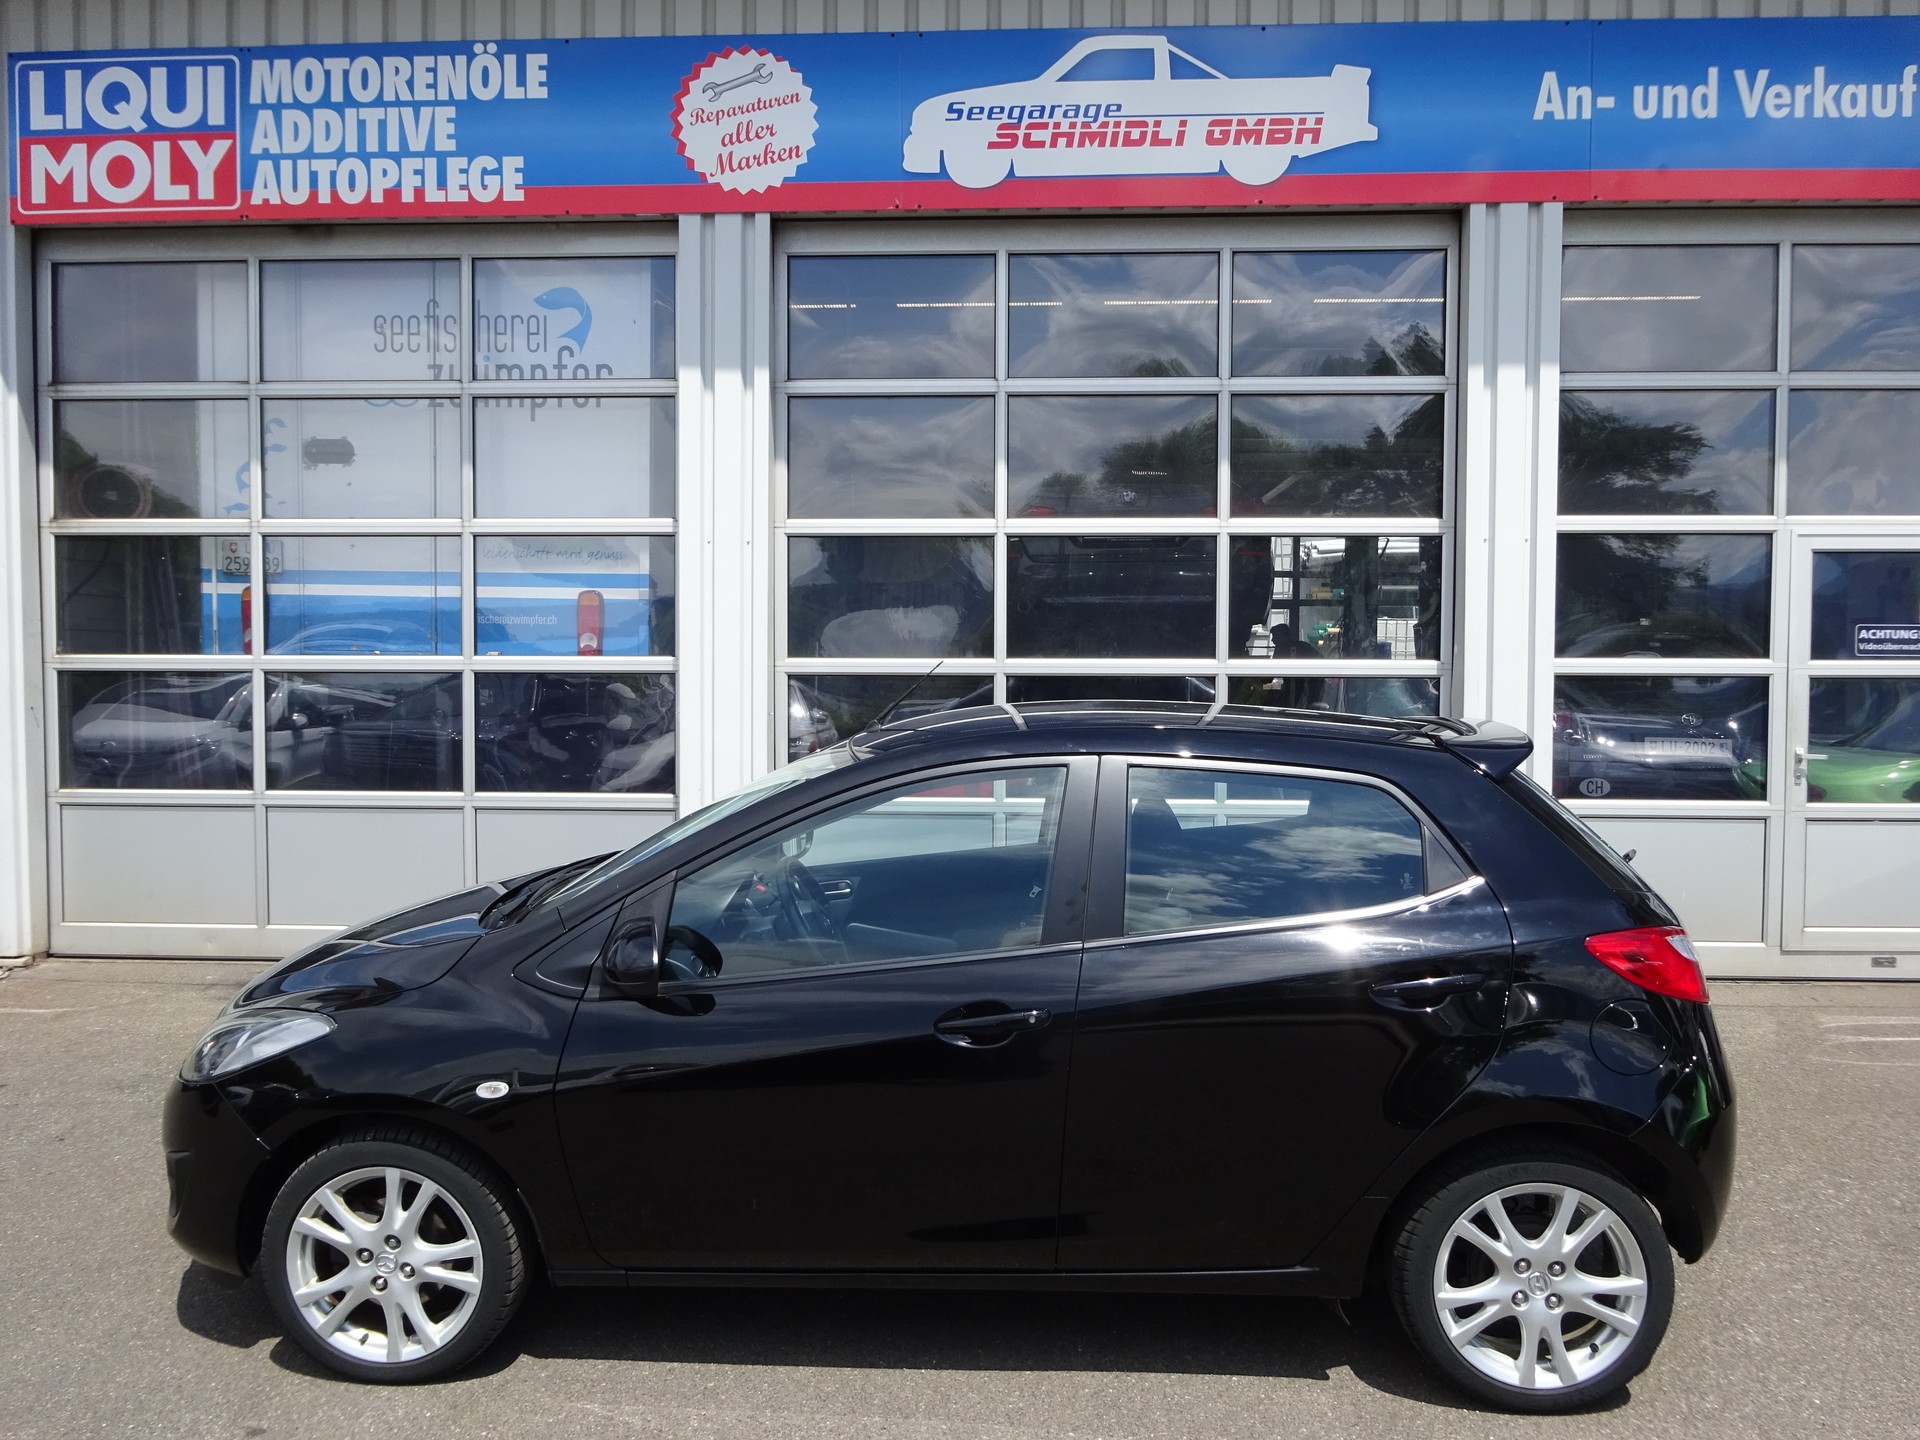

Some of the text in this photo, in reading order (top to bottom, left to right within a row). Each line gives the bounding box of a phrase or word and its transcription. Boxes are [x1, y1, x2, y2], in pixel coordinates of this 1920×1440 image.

[249, 42, 548, 105] MOTORENÖLE
[29, 64, 226, 133] LIQUI
[689, 92, 802, 126] Reparaturen
[1532, 65, 1918, 120] An- und Verkauf
[250, 106, 457, 155] ADDITIVE
[945, 101, 1123, 125] Seegarage
[720, 119, 777, 148] aller
[1204, 117, 1325, 147] GMBH
[31, 139, 234, 204] MOLY
[709, 142, 803, 177] Marken
[250, 155, 525, 206] AUTOPFLEGE
[373, 299, 548, 353] seefisherei
[225, 556, 280, 572] 25989
[476, 613, 558, 628] ischereizwimpfer.ch
[1586, 780, 1604, 794] CH
